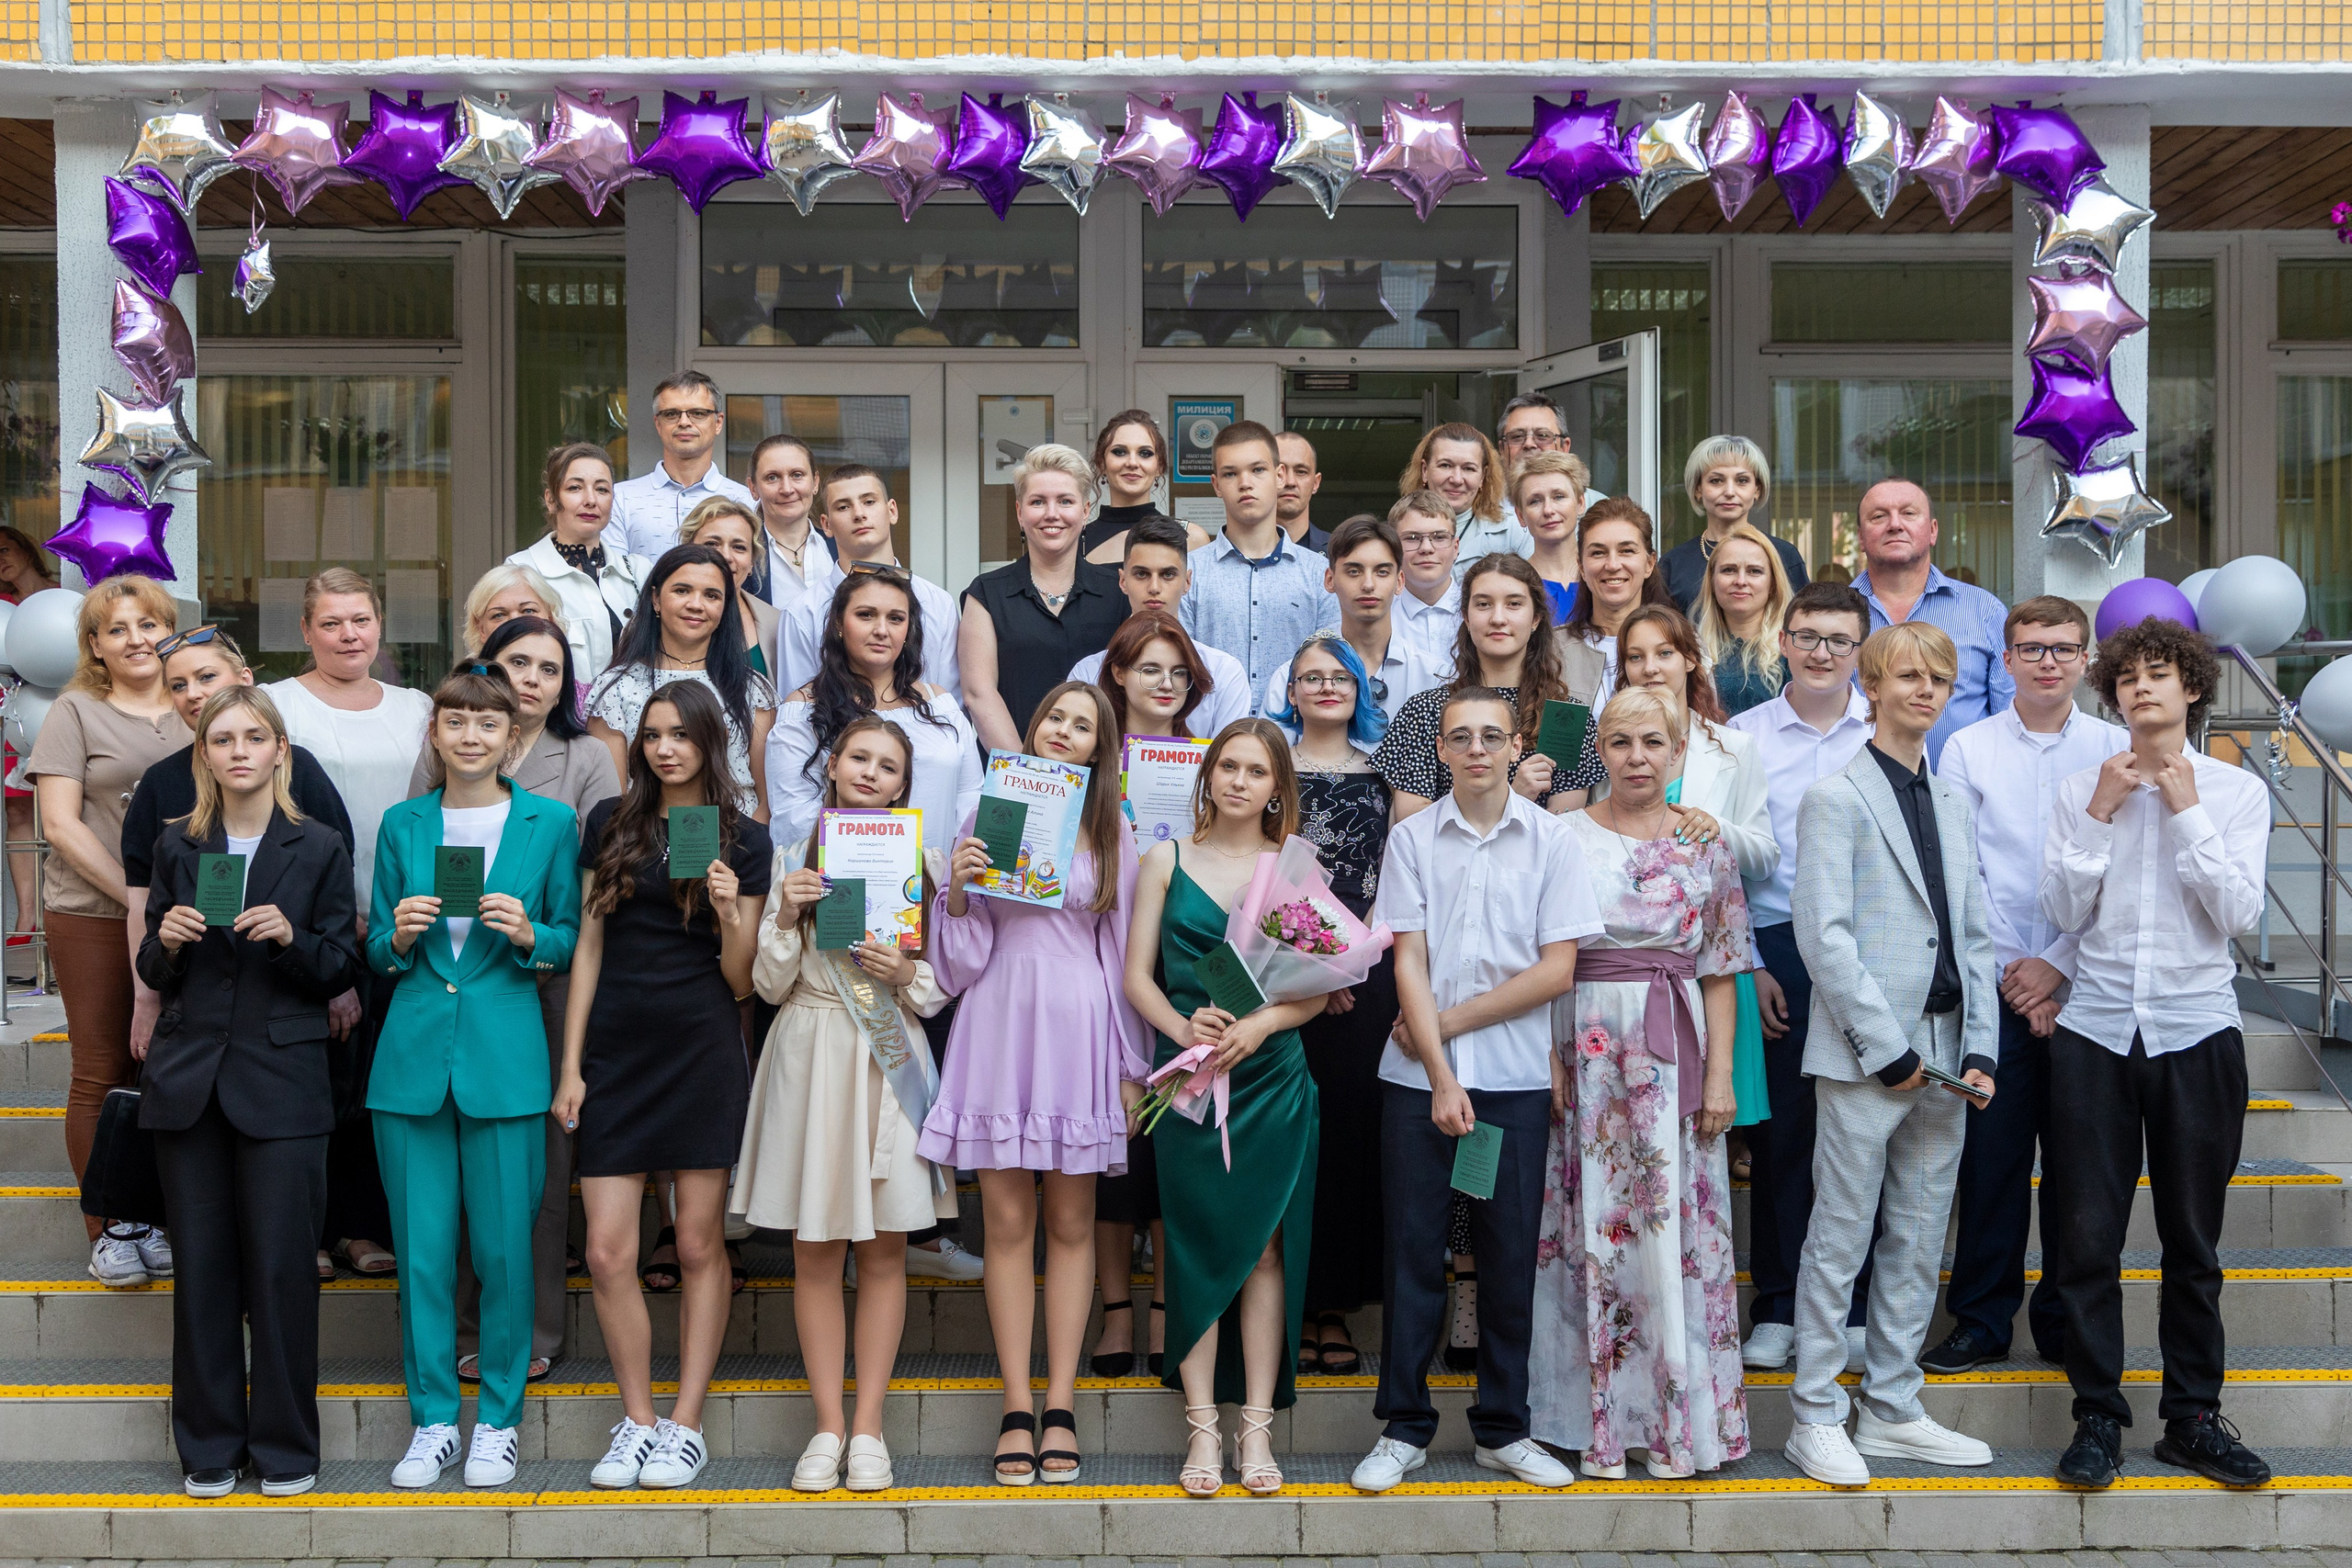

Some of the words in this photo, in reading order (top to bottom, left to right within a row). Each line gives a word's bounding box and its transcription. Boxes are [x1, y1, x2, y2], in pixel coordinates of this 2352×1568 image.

[1177, 405, 1232, 414] МИЛИЦИЯ
[1140, 749, 1204, 765] ГРАМОТА
[1003, 774, 1067, 797] ГРАМОТА
[838, 822, 905, 836] ГРАМОТА
[861, 1010, 912, 1072] 2024
